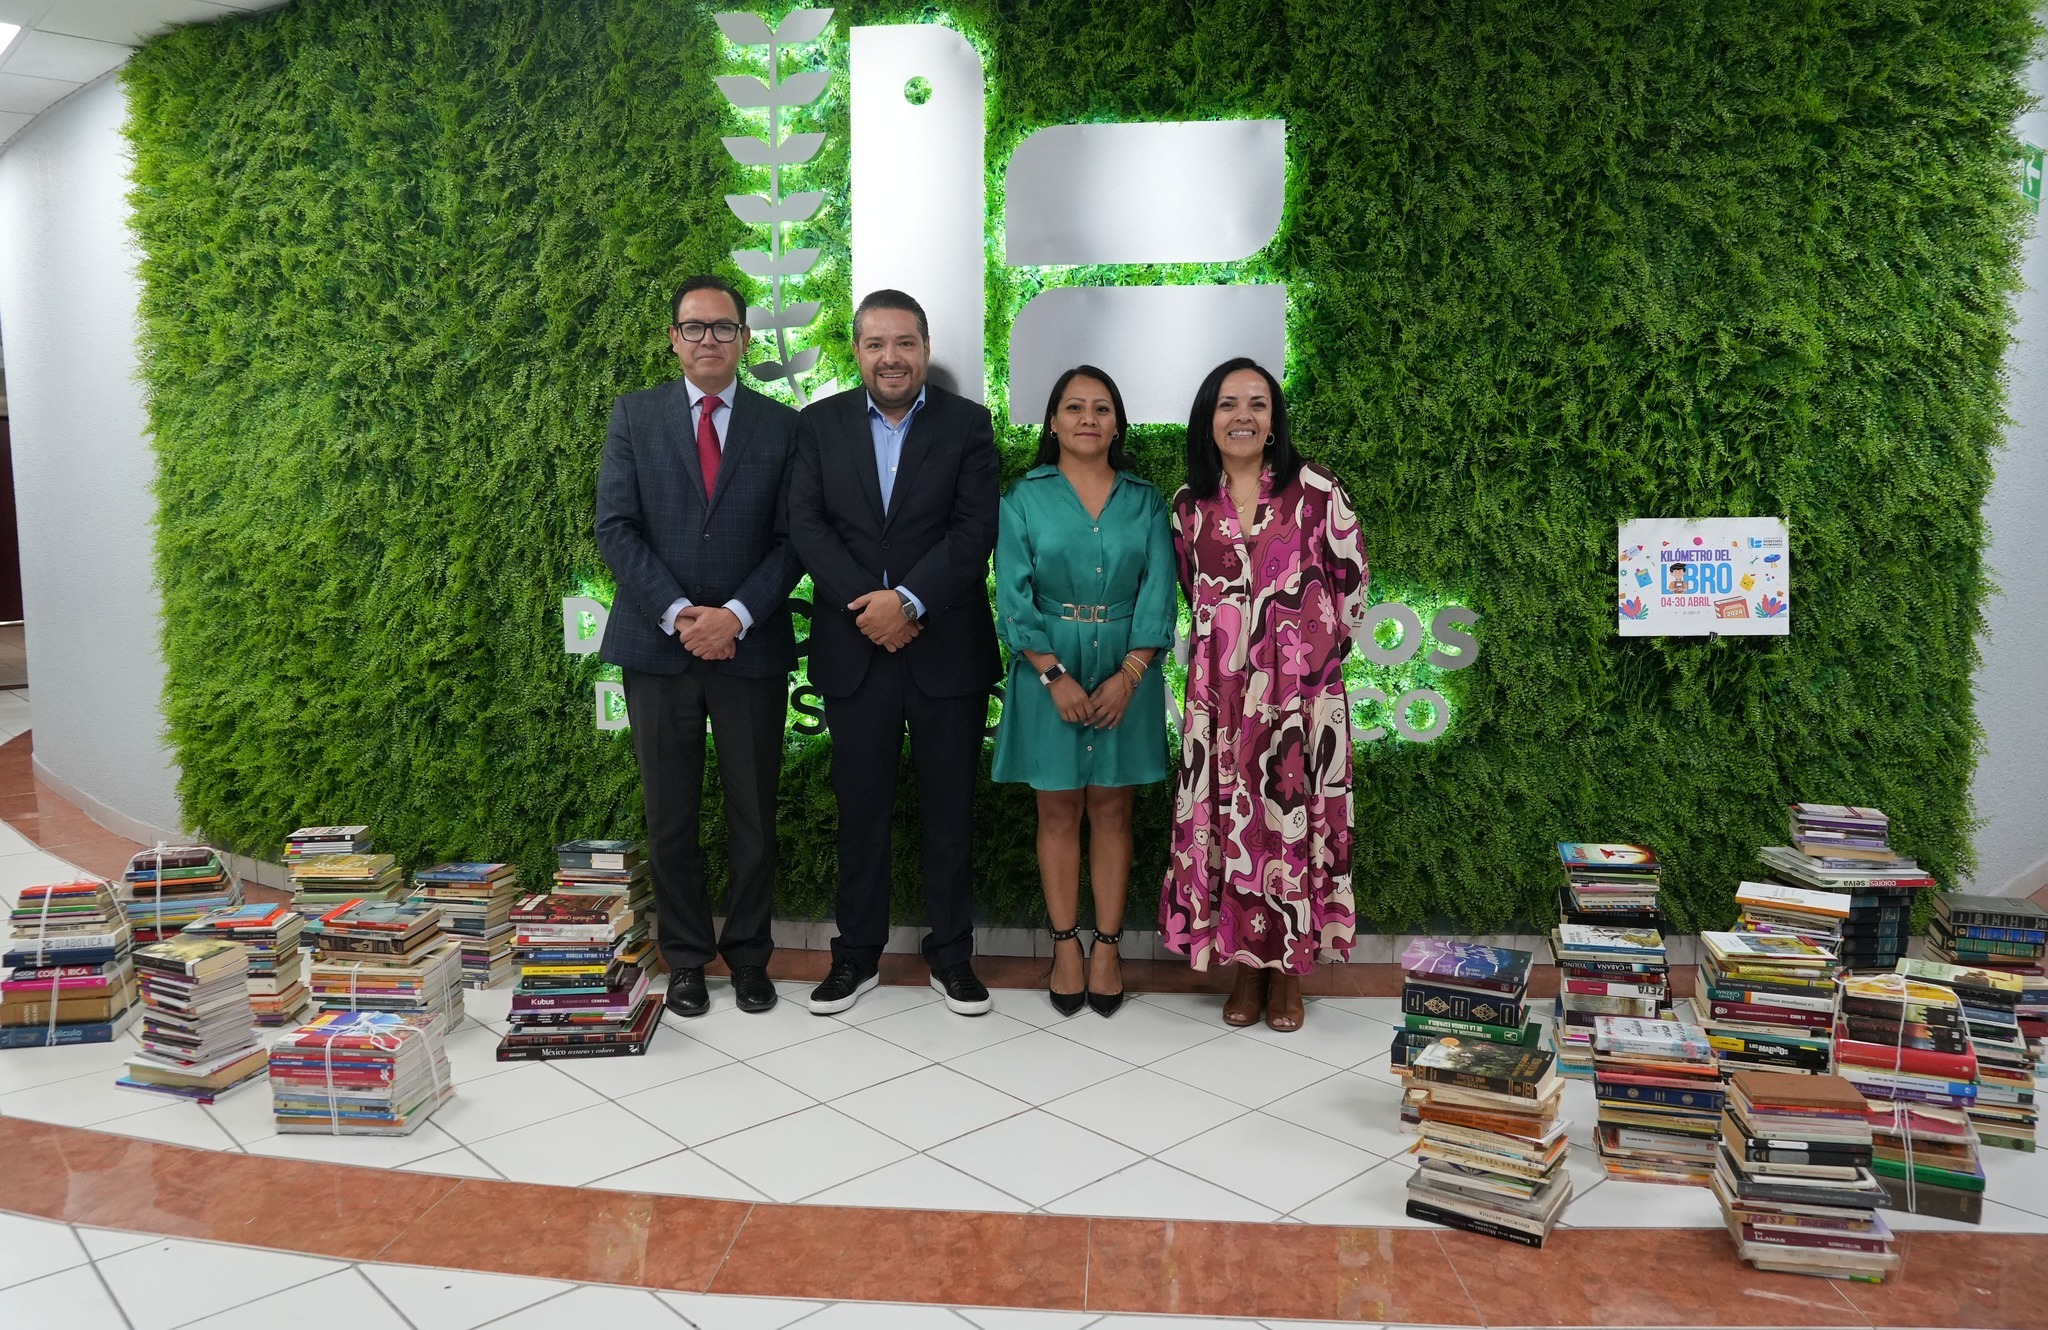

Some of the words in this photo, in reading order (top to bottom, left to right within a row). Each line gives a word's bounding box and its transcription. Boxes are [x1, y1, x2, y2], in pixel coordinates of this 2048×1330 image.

[1660, 548, 1712, 562] KILÓMETRO
[1714, 549, 1732, 561] DEL
[1660, 596, 1686, 608] 04-30
[1688, 596, 1711, 607] ABRIL
[1726, 609, 1743, 617] 2024
[1869, 879, 1896, 887] colores
[37, 969, 66, 978] COSA
[67, 968, 88, 976] RICA
[1638, 985, 1663, 996] ZETA
[1781, 999, 1807, 1007] inteligencia
[1428, 1020, 1451, 1028] ESPAÑOLA
[1451, 1023, 1468, 1031] LENGUA
[50, 1029, 82, 1038] álculo
[541, 1048, 567, 1056] México
[1474, 1156, 1498, 1166] VIVAS
[1501, 1162, 1532, 1173] LETRAS
[1754, 1234, 1786, 1244] LLAMAS
